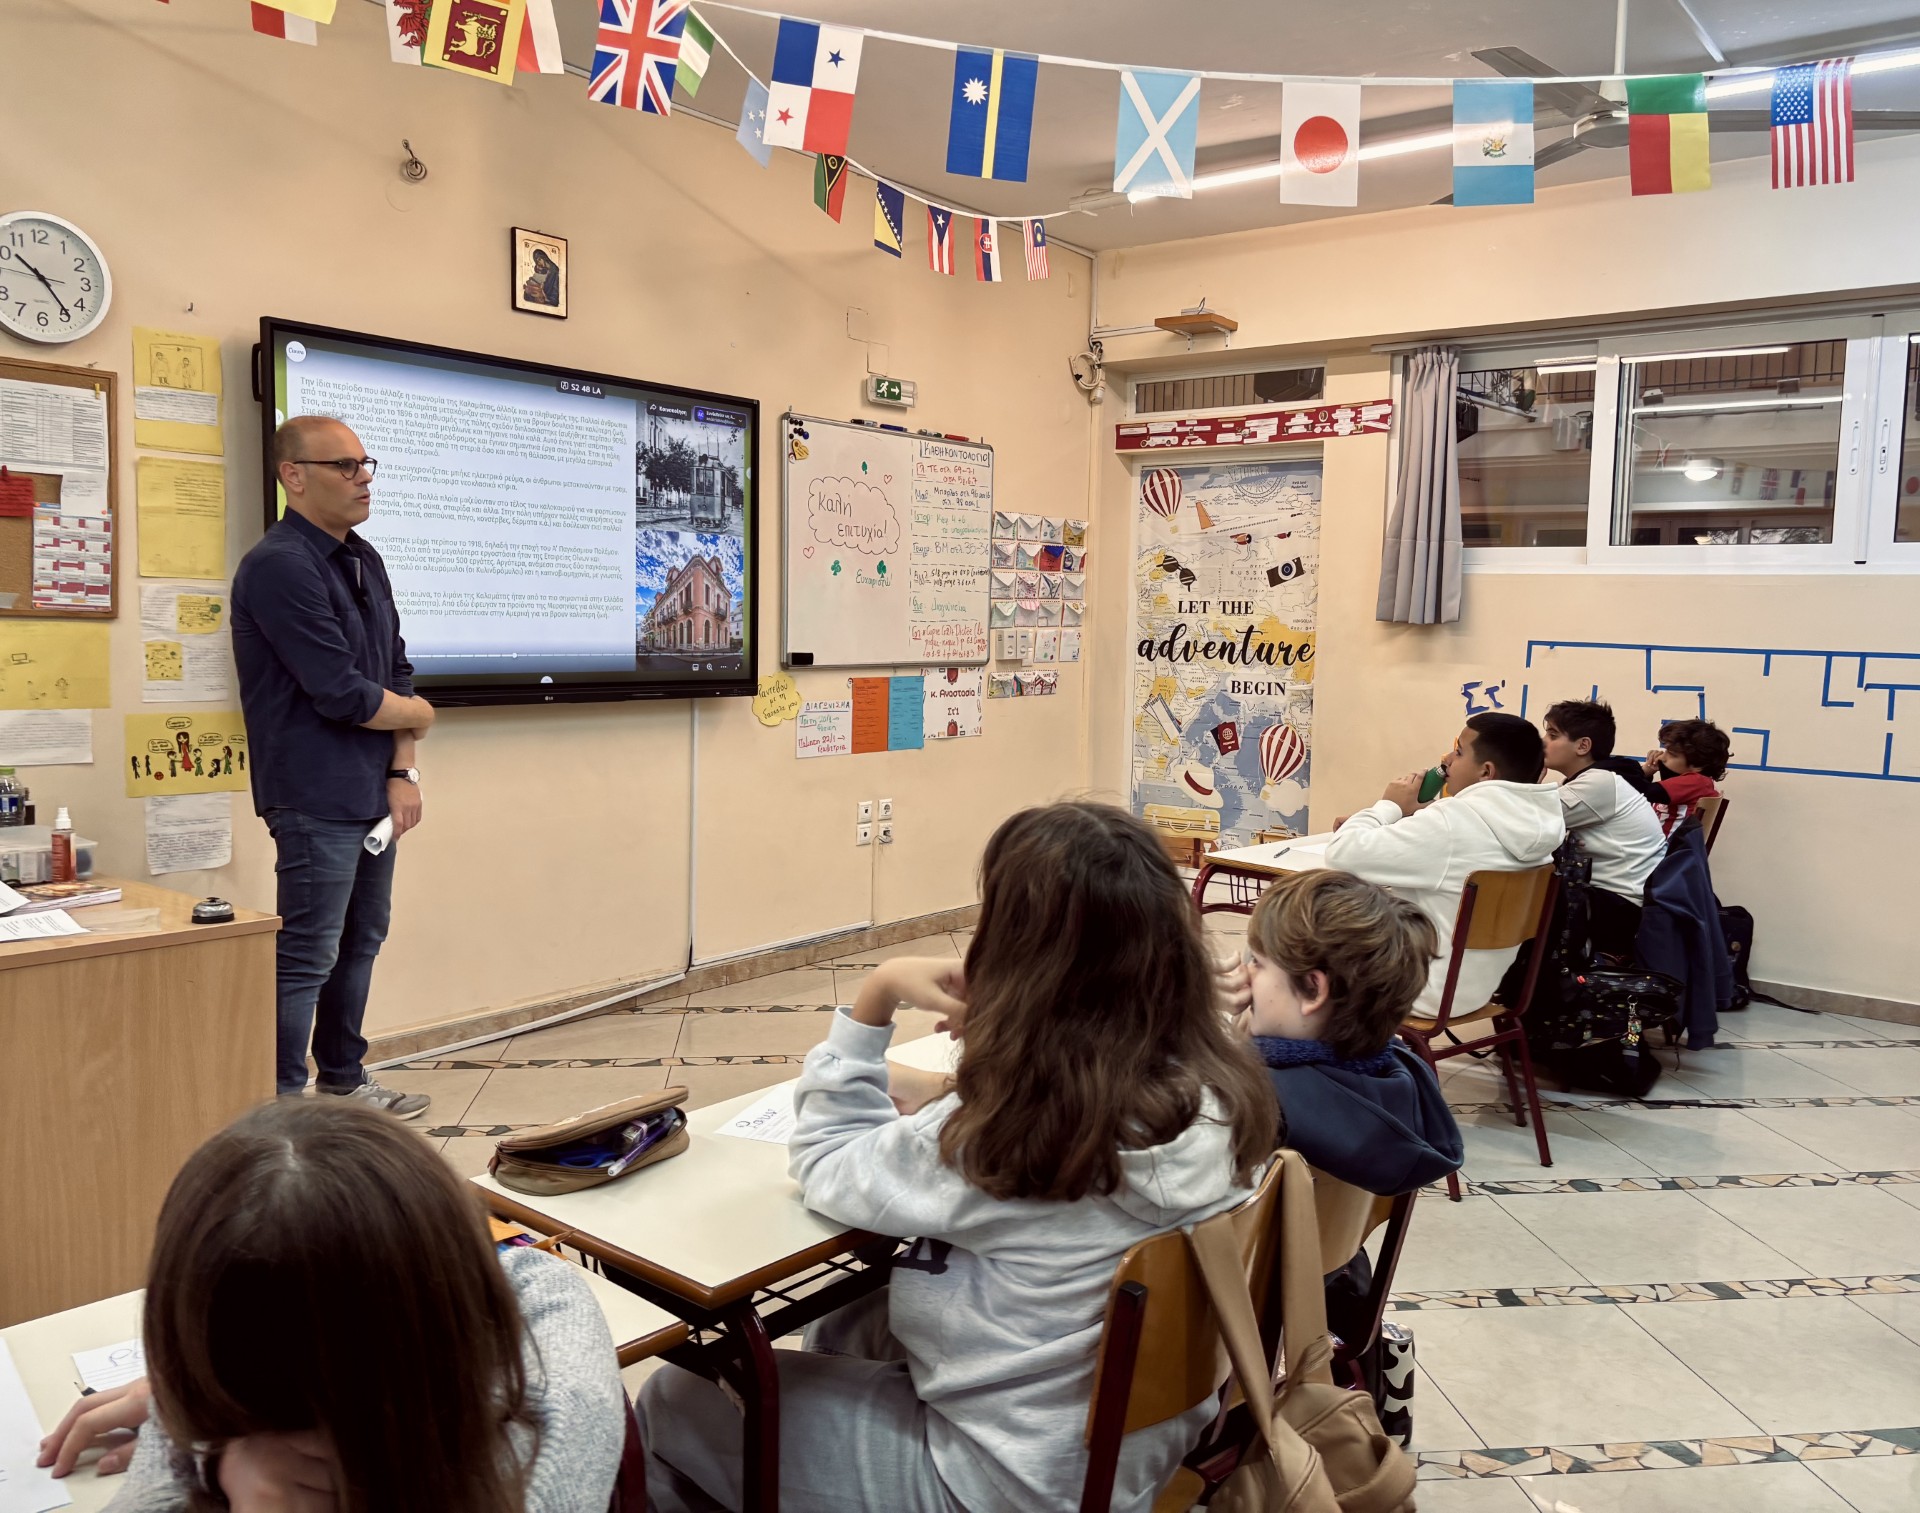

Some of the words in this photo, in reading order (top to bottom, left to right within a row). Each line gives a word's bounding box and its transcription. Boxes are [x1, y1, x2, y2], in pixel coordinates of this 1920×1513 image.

[10, 232, 24, 248] 11
[30, 228, 50, 245] 12
[0, 245, 11, 260] 0
[60, 240, 66, 254] 1
[73, 258, 85, 272] 2
[80, 277, 91, 292] 3
[15, 302, 26, 316] 7
[74, 298, 86, 312] 4
[37, 312, 48, 326] 6
[59, 308, 71, 322] 5
[571, 383, 580, 391] S2
[582, 385, 591, 393] 48
[592, 386, 601, 395] LA
[301, 378, 314, 388] Την
[316, 380, 331, 389] ίδια
[332, 384, 363, 393] περίοδο
[380, 389, 404, 400] άλλαζε
[412, 395, 444, 405] οικονομία
[446, 399, 457, 407] της
[459, 400, 495, 413] Καλαμάτας,
[497, 404, 517, 415] άλλαζε
[534, 410, 567, 422] πληθυσμός
[300, 397, 320, 408] Έτσι,
[321, 401, 336, 409] από
[349, 404, 365, 412] 1879
[366, 406, 386, 416] μέχρι
[397, 410, 413, 418] 1896
[420, 413, 457, 425] πληθυσμός
[459, 419, 469, 427] της
[471, 419, 490, 430] πόλης
[491, 423, 513, 431] σχεδόν
[329, 393, 351, 401] χωριά
[353, 395, 372, 405] γύρω
[403, 401, 437, 412] Καλαμάτα
[439, 407, 478, 418] μετακόμιζαν
[479, 412, 494, 420] στην
[496, 413, 511, 423] πόλη
[512, 416, 522, 424] για
[532, 418, 550, 427] βρουν
[301, 407, 316, 417] Στις
[356, 413, 374, 422] 20ού
[375, 416, 397, 424] αιώνα
[405, 419, 438, 430] Καλαμάτα
[440, 424, 472, 433] μεγάλωνε
[484, 428, 508, 438] πήγαινε
[392, 428, 428, 438] φτιάχτηκε
[429, 432, 476, 445] σιδηρόδρομος
[489, 438, 509, 447] έγιναν
[510, 442, 540, 451] σημαντικά
[389, 436, 416, 447] εύκολα,
[417, 439, 434, 447] τόσο
[436, 441, 449, 449] από
[460, 445, 480, 453] στεριά
[482, 445, 494, 454] όσο
[528, 451, 556, 462] θάλασσα,
[404, 446, 440, 456] εξωτερικό.
[394, 465, 449, 476] εκσυγχρονίζεται:
[451, 470, 471, 479] μπήκε
[472, 472, 502, 481] ηλεκτρικό
[504, 475, 525, 484] ρεύμα,
[400, 473, 431, 482] χτίζονταν
[432, 476, 459, 486] όμορφα
[460, 480, 496, 488] νεοκλασικά
[377, 489, 416, 500] δραστήριο.
[417, 492, 438, 501] Πολλά
[460, 496, 495, 505] μαζεύονταν
[510, 500, 526, 509] τέλος
[818, 492, 852, 517] Καλή
[403, 500, 421, 510] όπως
[423, 502, 441, 512] σύκα,
[443, 504, 471, 513] σταφίδα
[516, 509, 531, 518] πόλη
[403, 510, 422, 519] ποτά,
[423, 512, 456, 522] σαπούνια,
[477, 516, 511, 525] κονσέρβες,
[512, 517, 537, 527] δέρματα
[837, 520, 887, 544] επιτυχία!
[369, 535, 410, 545] συνεχίστηκε
[412, 537, 430, 546] μέχρι
[431, 538, 457, 547] περίπου
[485, 541, 508, 550] δηλαδή
[522, 543, 539, 552] εποχή
[386, 545, 403, 554] 1920,
[442, 548, 479, 557] μεγαλύτερα
[480, 550, 516, 558] εργοστάσια
[423, 564, 464, 574] αλευρόμυλοι
[428, 556, 454, 564] περίπου
[497, 559, 527, 568] Αργότερα,
[528, 560, 554, 569] ανάμεσα
[410, 590, 432, 599] αιώνα,
[443, 591, 463, 599] λιμάνι
[476, 592, 510, 601] Καλαμάτας
[511, 592, 525, 601] ήταν
[471, 600, 497, 609] έφευγαν
[1178, 601, 1210, 614] LET
[1219, 601, 1254, 615] THE
[444, 609, 488, 617] μετανάστευαν
[506, 610, 530, 618] Αμερική
[1137, 623, 1316, 666] adventure
[940, 688, 976, 698] Αναστασία
[1231, 680, 1286, 696] BEGIN
